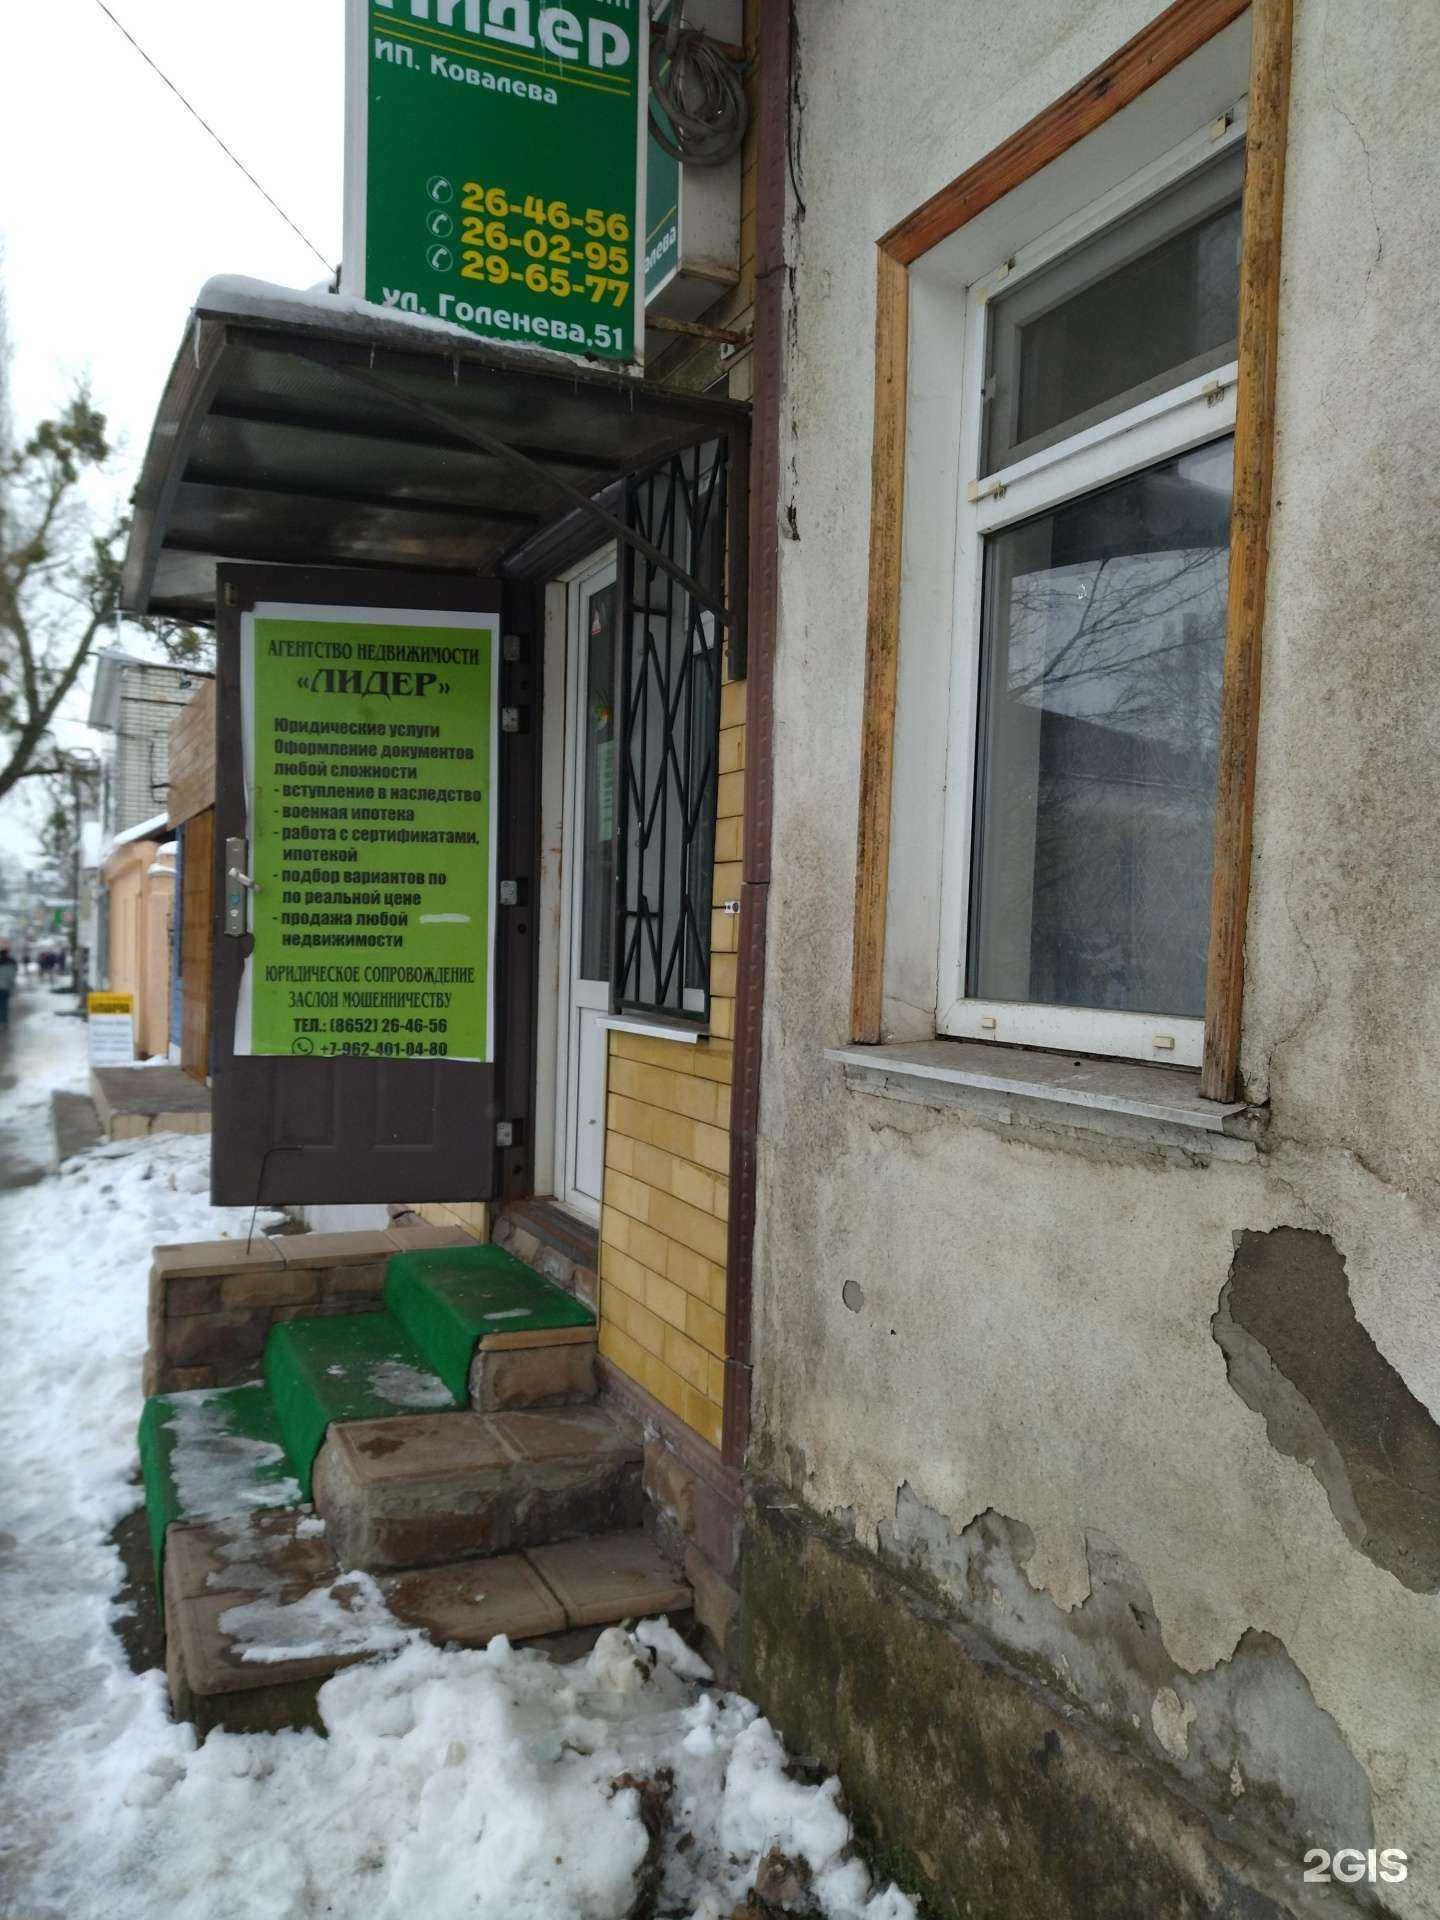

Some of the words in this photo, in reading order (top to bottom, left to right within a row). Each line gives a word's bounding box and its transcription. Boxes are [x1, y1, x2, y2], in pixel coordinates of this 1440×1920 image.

[430, 54, 558, 105] Ковалева
[461, 182, 630, 242] 26-46-56
[461, 216, 630, 275] 26-02-95
[461, 250, 630, 307] 29-65-77
[268, 640, 352, 660] АГЕНТСТВО
[357, 643, 480, 665] НЕДВИЖИМОСТИ
[274, 717, 386, 738] Юридические
[389, 724, 440, 738] услуги
[274, 739, 378, 757] Оформление
[381, 744, 475, 760] документов
[273, 761, 327, 777] любой
[331, 764, 418, 779] сложности
[282, 785, 374, 799] вступление
[378, 787, 386, 799] в
[390, 788, 482, 803] наследство
[282, 806, 348, 819] военная
[351, 808, 415, 821] ипотека
[282, 826, 336, 841] работа
[340, 829, 348, 840] с
[283, 847, 358, 862] ипотекой
[282, 869, 340, 884] подбор
[344, 871, 425, 884] вариантов
[428, 873, 446, 885] по
[282, 891, 300, 904] по
[304, 890, 381, 905] реальной
[384, 892, 422, 907] цене
[281, 912, 352, 926] продажа
[356, 912, 409, 926] любой
[282, 933, 404, 948] недвижимости
[265, 965, 360, 983] ЮРИДИЧЕСКОЕ
[364, 966, 475, 984] СОПРОВОЖДЕНИЕ
[288, 991, 339, 1008] ЗАСЛОН
[343, 991, 453, 1009] МОШЕННИЧЕСТВУ
[293, 1018, 327, 1033] ТЕЛ.:
[330, 1018, 378, 1033] (8652)
[382, 1018, 448, 1033] 26-46-56
